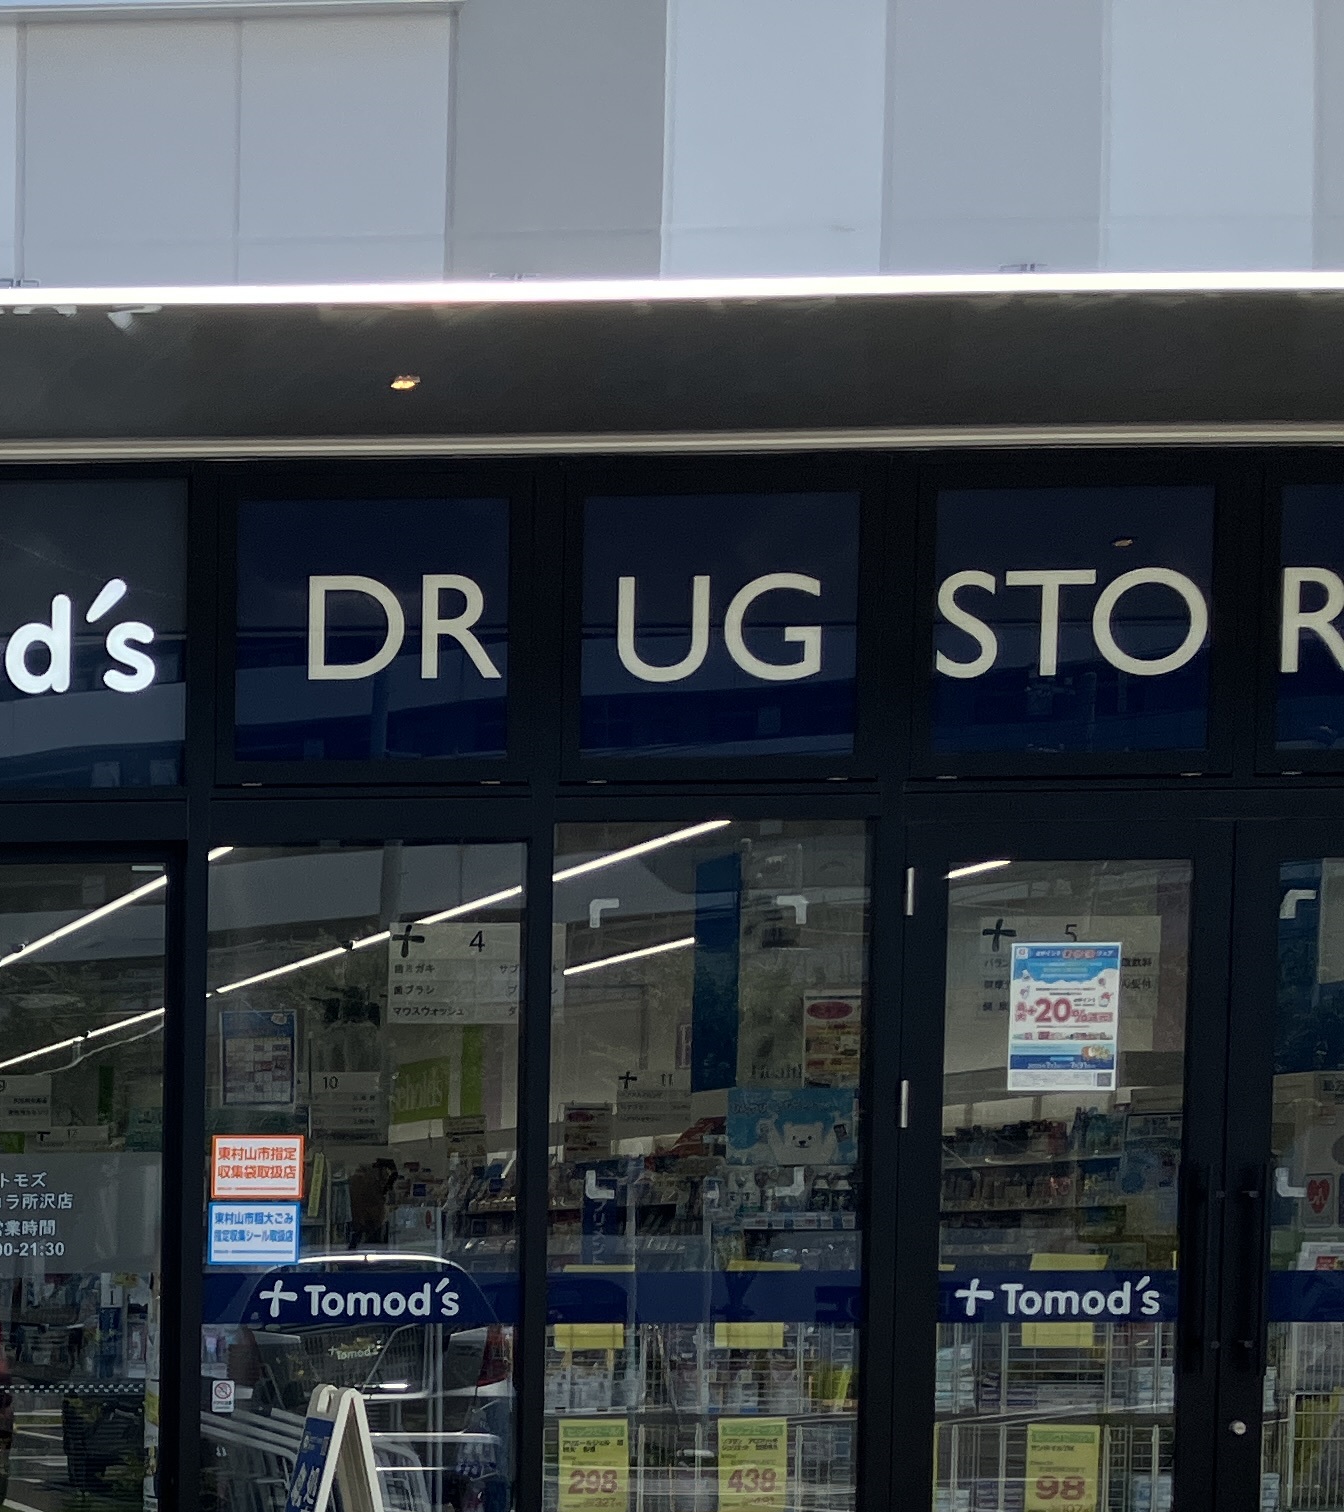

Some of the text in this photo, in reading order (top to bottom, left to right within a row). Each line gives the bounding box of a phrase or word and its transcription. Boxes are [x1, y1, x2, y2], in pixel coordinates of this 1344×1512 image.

[469, 929, 485, 953] 4
[1064, 924, 1077, 942] 5
[322, 1075, 339, 1089] 10
[217, 1147, 297, 1161] 東村山市指定
[0, 1172, 47, 1189] トモズ
[217, 1165, 297, 1179] 収集袋取扱店
[304, 1277, 460, 1318] Tomod's
[1000, 1276, 1161, 1316] Tomod's
[568, 1469, 618, 1495] 298
[727, 1468, 777, 1493] 438
[1035, 1475, 1086, 1500] 98
